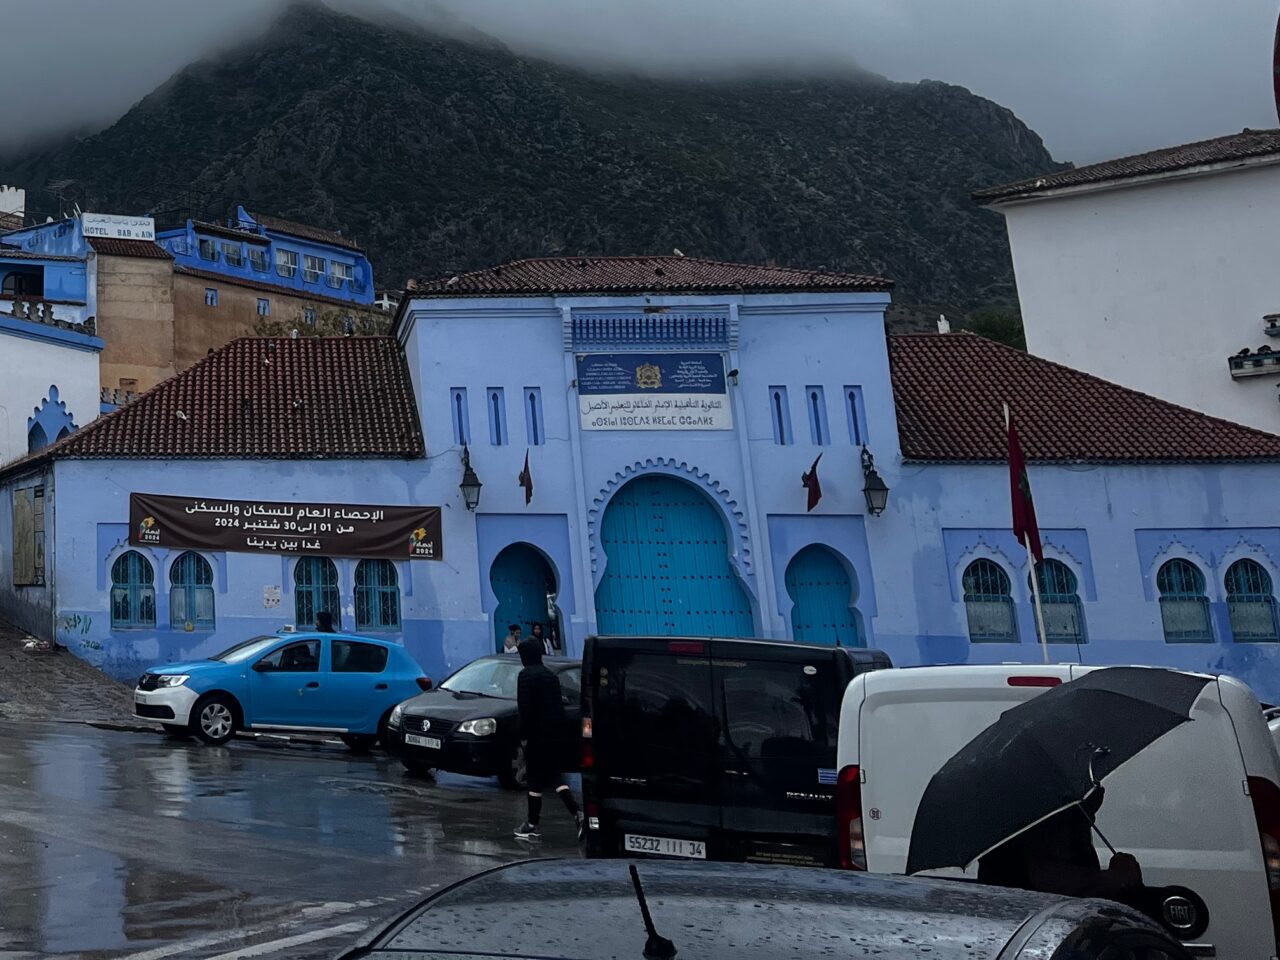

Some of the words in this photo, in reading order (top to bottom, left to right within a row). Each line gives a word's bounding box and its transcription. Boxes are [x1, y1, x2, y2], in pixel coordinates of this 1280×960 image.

[84, 226, 109, 236] HOTEL
[117, 229, 132, 237] BAB
[141, 230, 153, 239] AIN
[185, 501, 240, 517] والسكنى
[243, 504, 294, 518] للسكان
[296, 507, 331, 520] العام
[214, 518, 240, 527] 2024
[333, 509, 384, 523] الإحصاء
[242, 518, 281, 531] شتنبر
[283, 521, 296, 530] 30
[297, 522, 317, 534] إلى
[320, 522, 332, 532] 01
[336, 523, 355, 534] من
[246, 536, 277, 550] يدينا
[280, 538, 298, 551] بين
[302, 539, 321, 549] غدا
[629, 836, 661, 852] 55232
[689, 842, 703, 856] 34
[1169, 905, 1190, 921] FIAT
